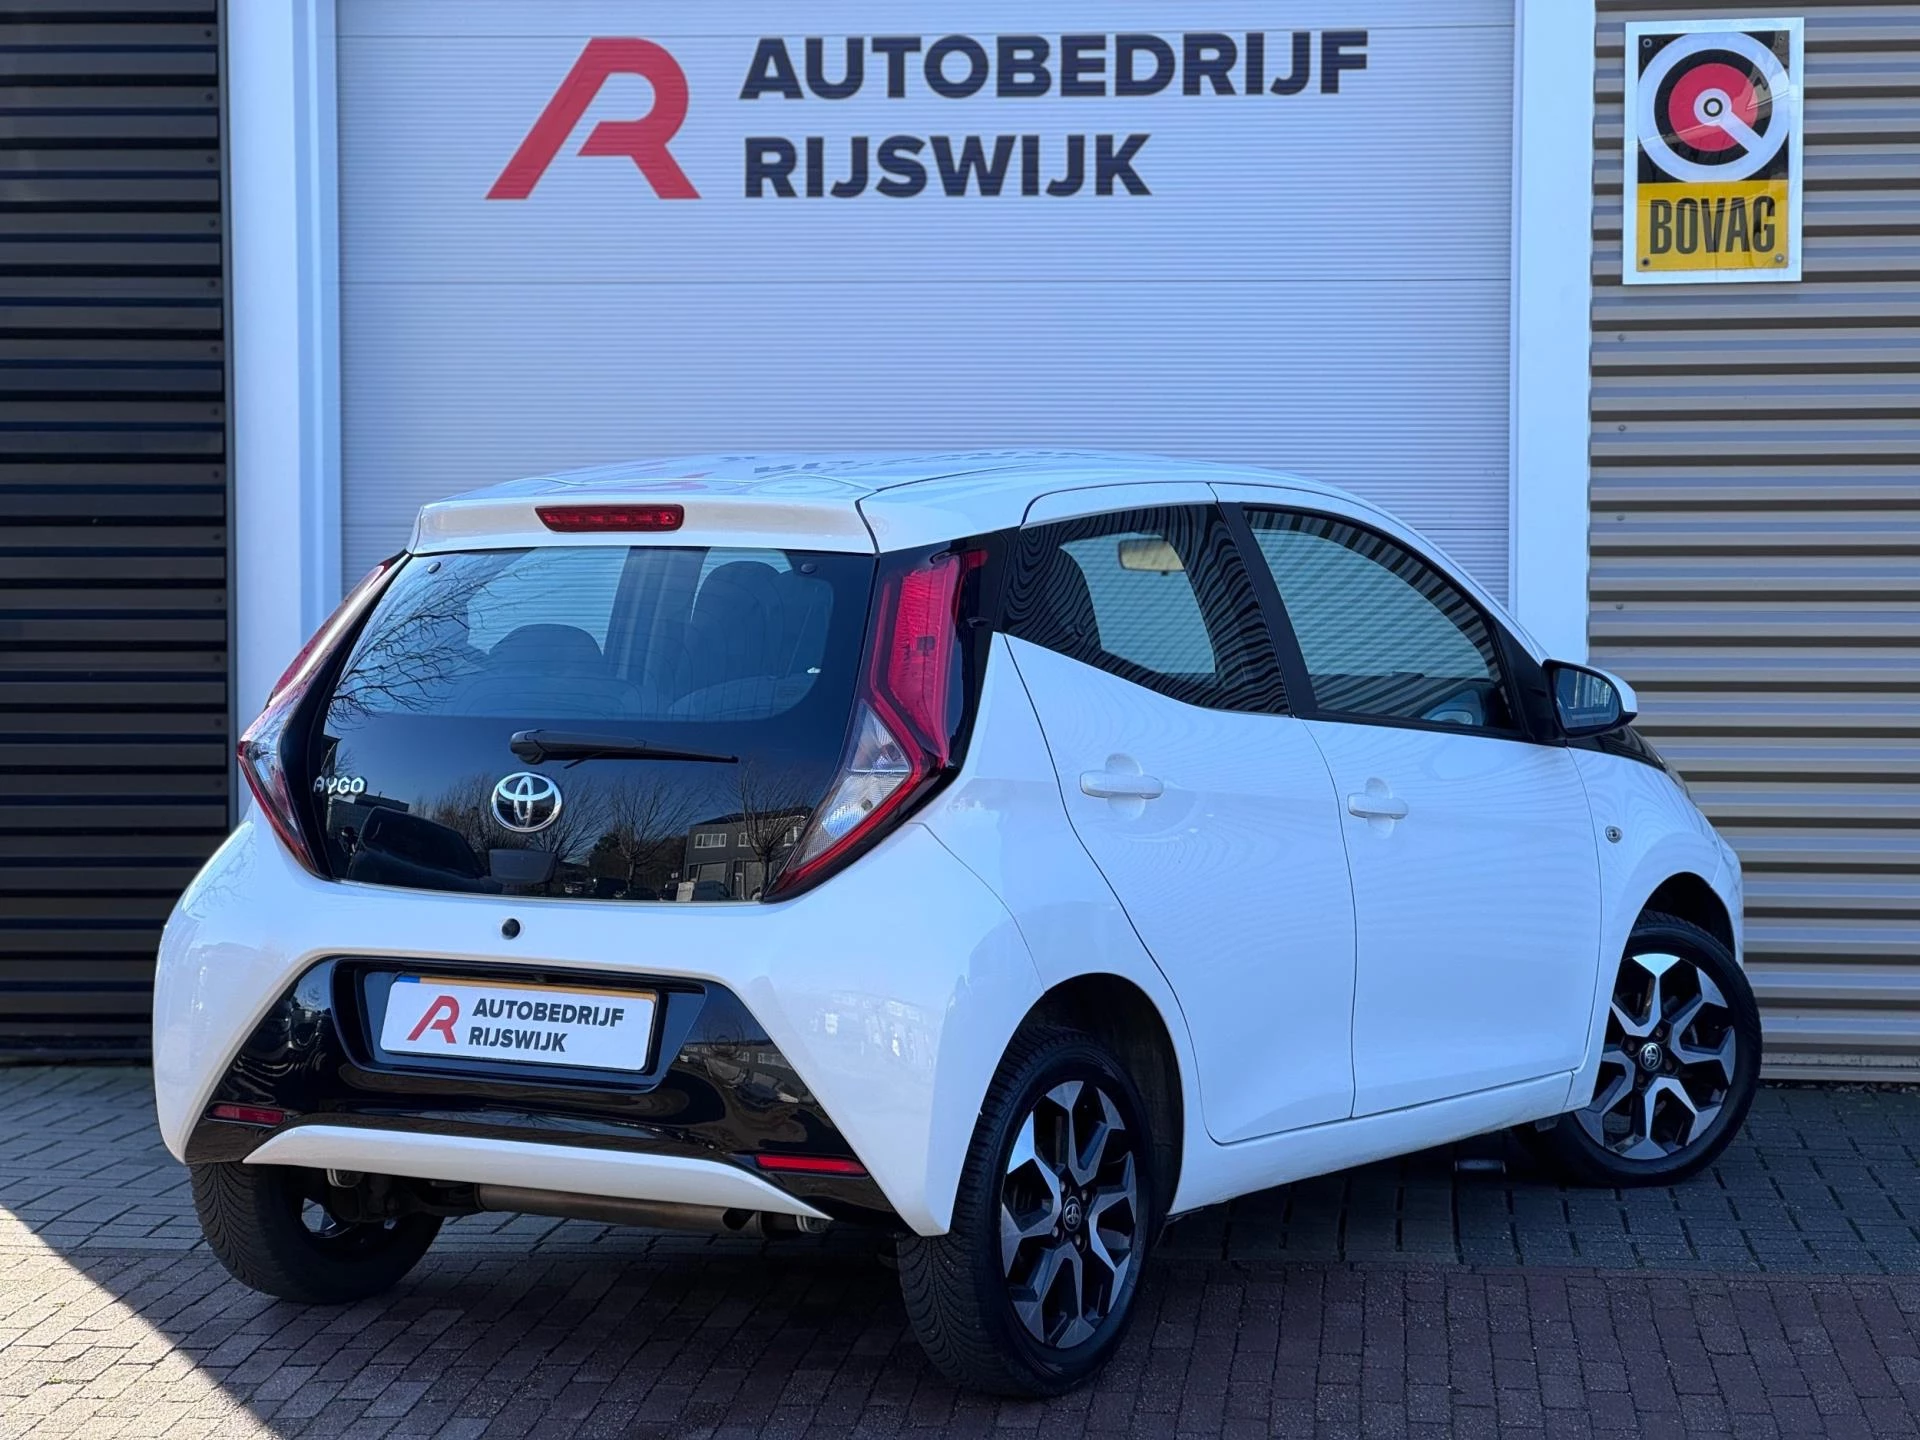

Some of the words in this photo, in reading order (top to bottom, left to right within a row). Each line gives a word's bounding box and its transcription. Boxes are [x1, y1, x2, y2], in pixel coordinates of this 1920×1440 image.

[739, 30, 1369, 99] AUTOBEDRIJF
[744, 134, 1153, 199] RIJSWIJK
[1650, 196, 1776, 255] BOVAG
[313, 775, 367, 795] AYGO
[472, 997, 625, 1028] AUTOBEDRIJF
[468, 1026, 568, 1053] RIJSWIJK
